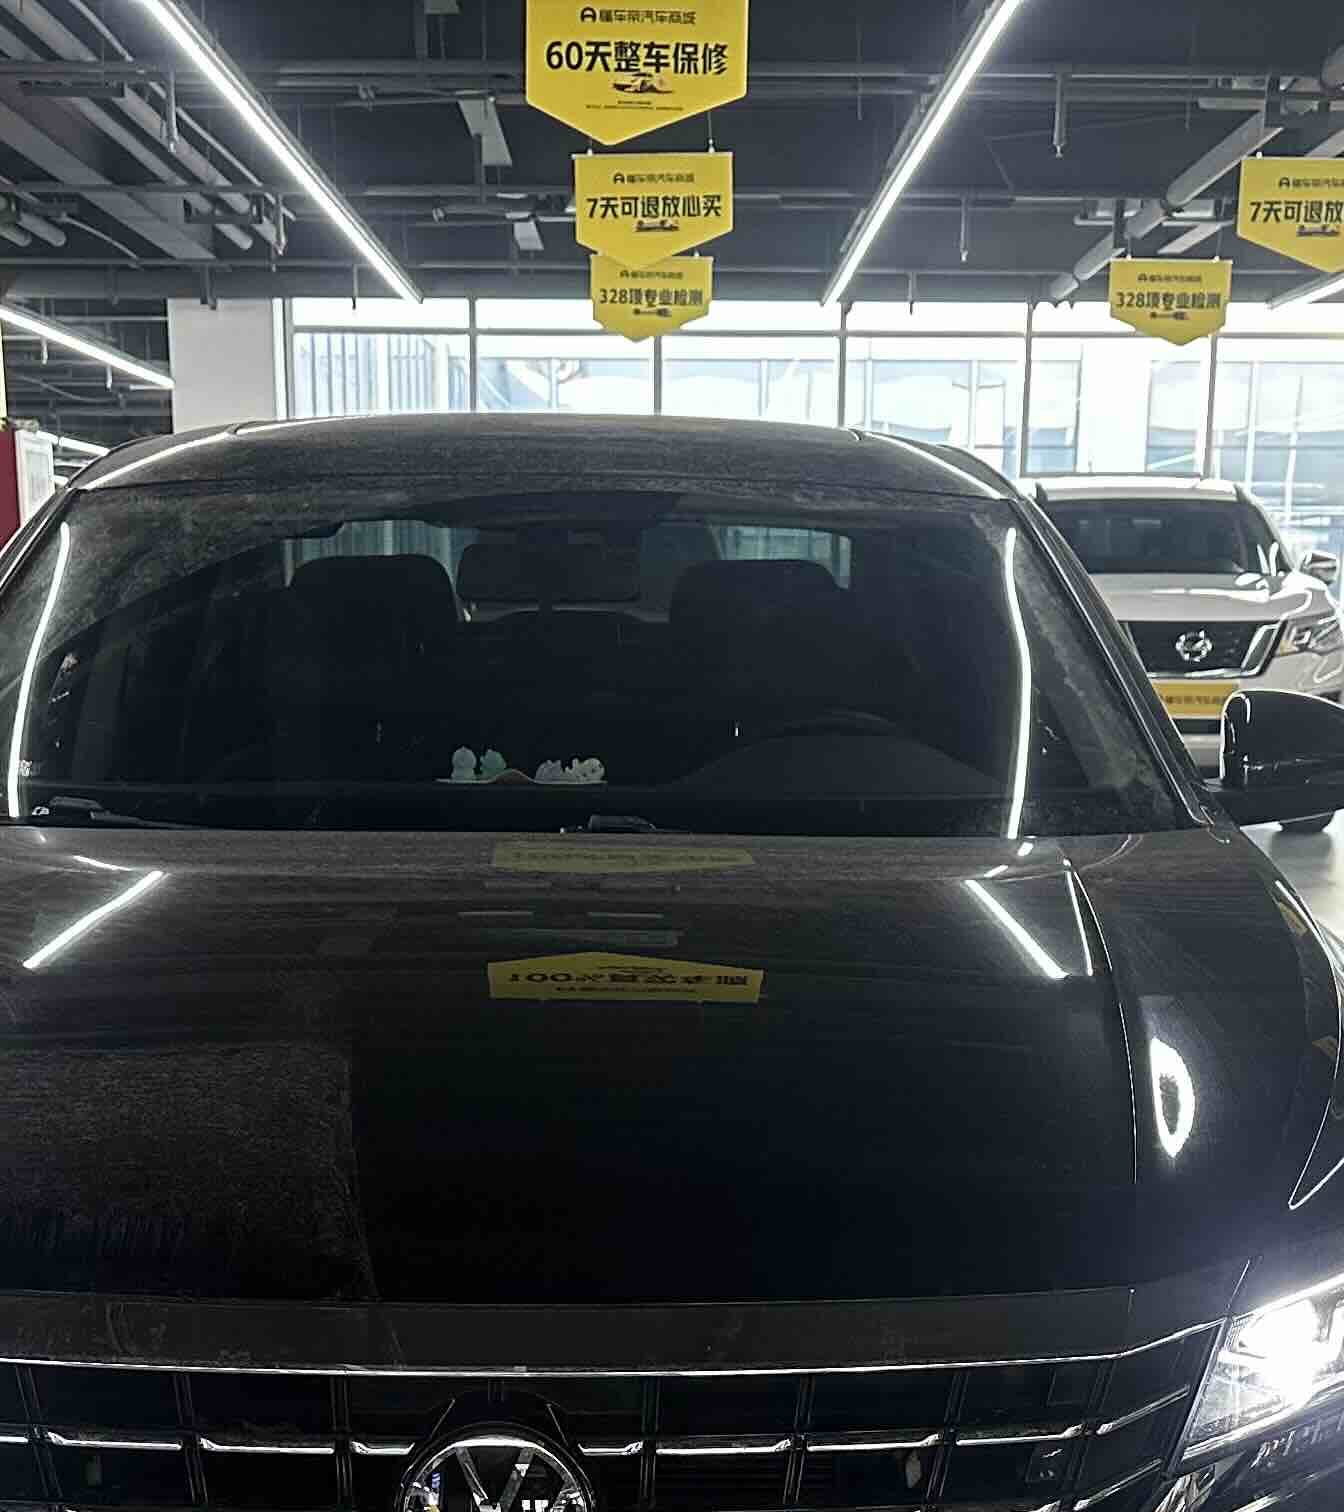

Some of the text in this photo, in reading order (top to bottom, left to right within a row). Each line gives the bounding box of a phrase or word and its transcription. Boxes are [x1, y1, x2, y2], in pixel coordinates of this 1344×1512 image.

[546, 40, 729, 75] 60天整车保修
[586, 195, 721, 218] 7天可退放心买
[599, 288, 703, 306] 328项专业检测
[1116, 292, 1221, 310] 328项专业检测
